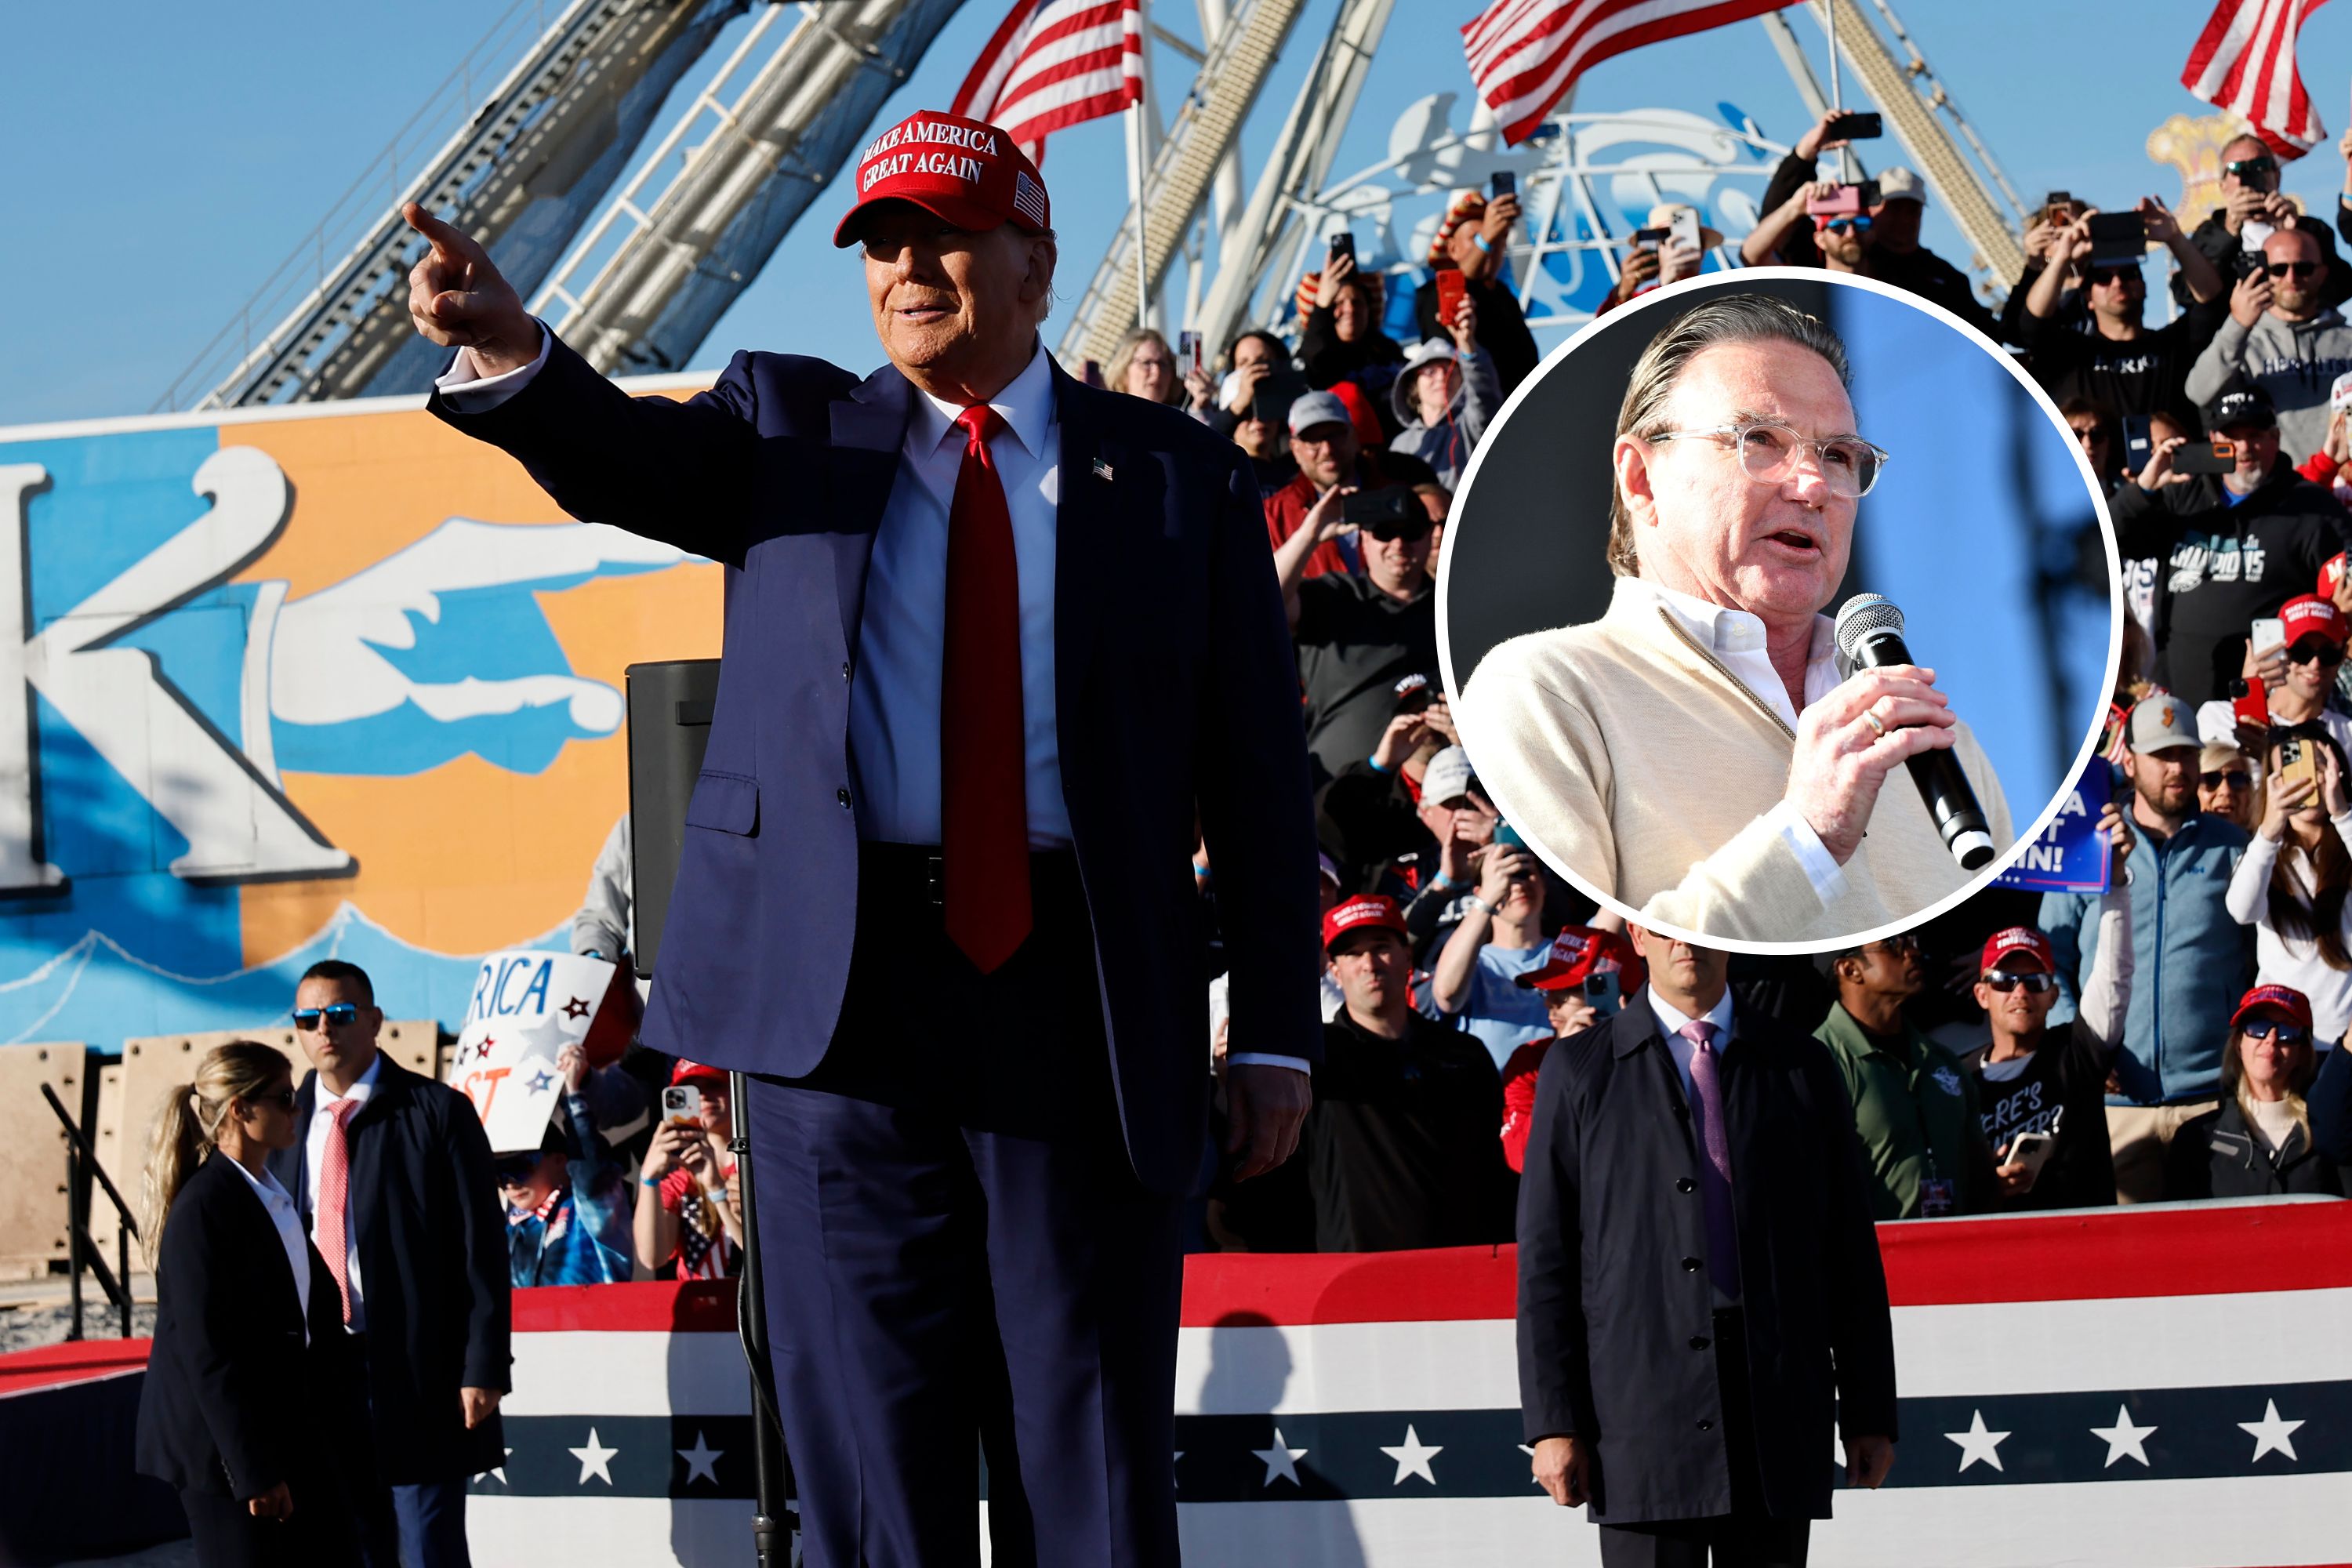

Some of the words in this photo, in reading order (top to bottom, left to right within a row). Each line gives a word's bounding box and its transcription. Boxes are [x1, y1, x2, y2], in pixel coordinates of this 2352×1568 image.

[859, 127, 902, 168] MAKE
[900, 122, 998, 157] AMERICA
[863, 153, 913, 193] GREAT
[913, 152, 983, 185] AGAIN
[2060, 790, 2087, 817] A
[2010, 844, 2063, 873] IN!
[452, 1067, 512, 1127] ST
[1980, 1081, 2042, 1134] ERE'S
